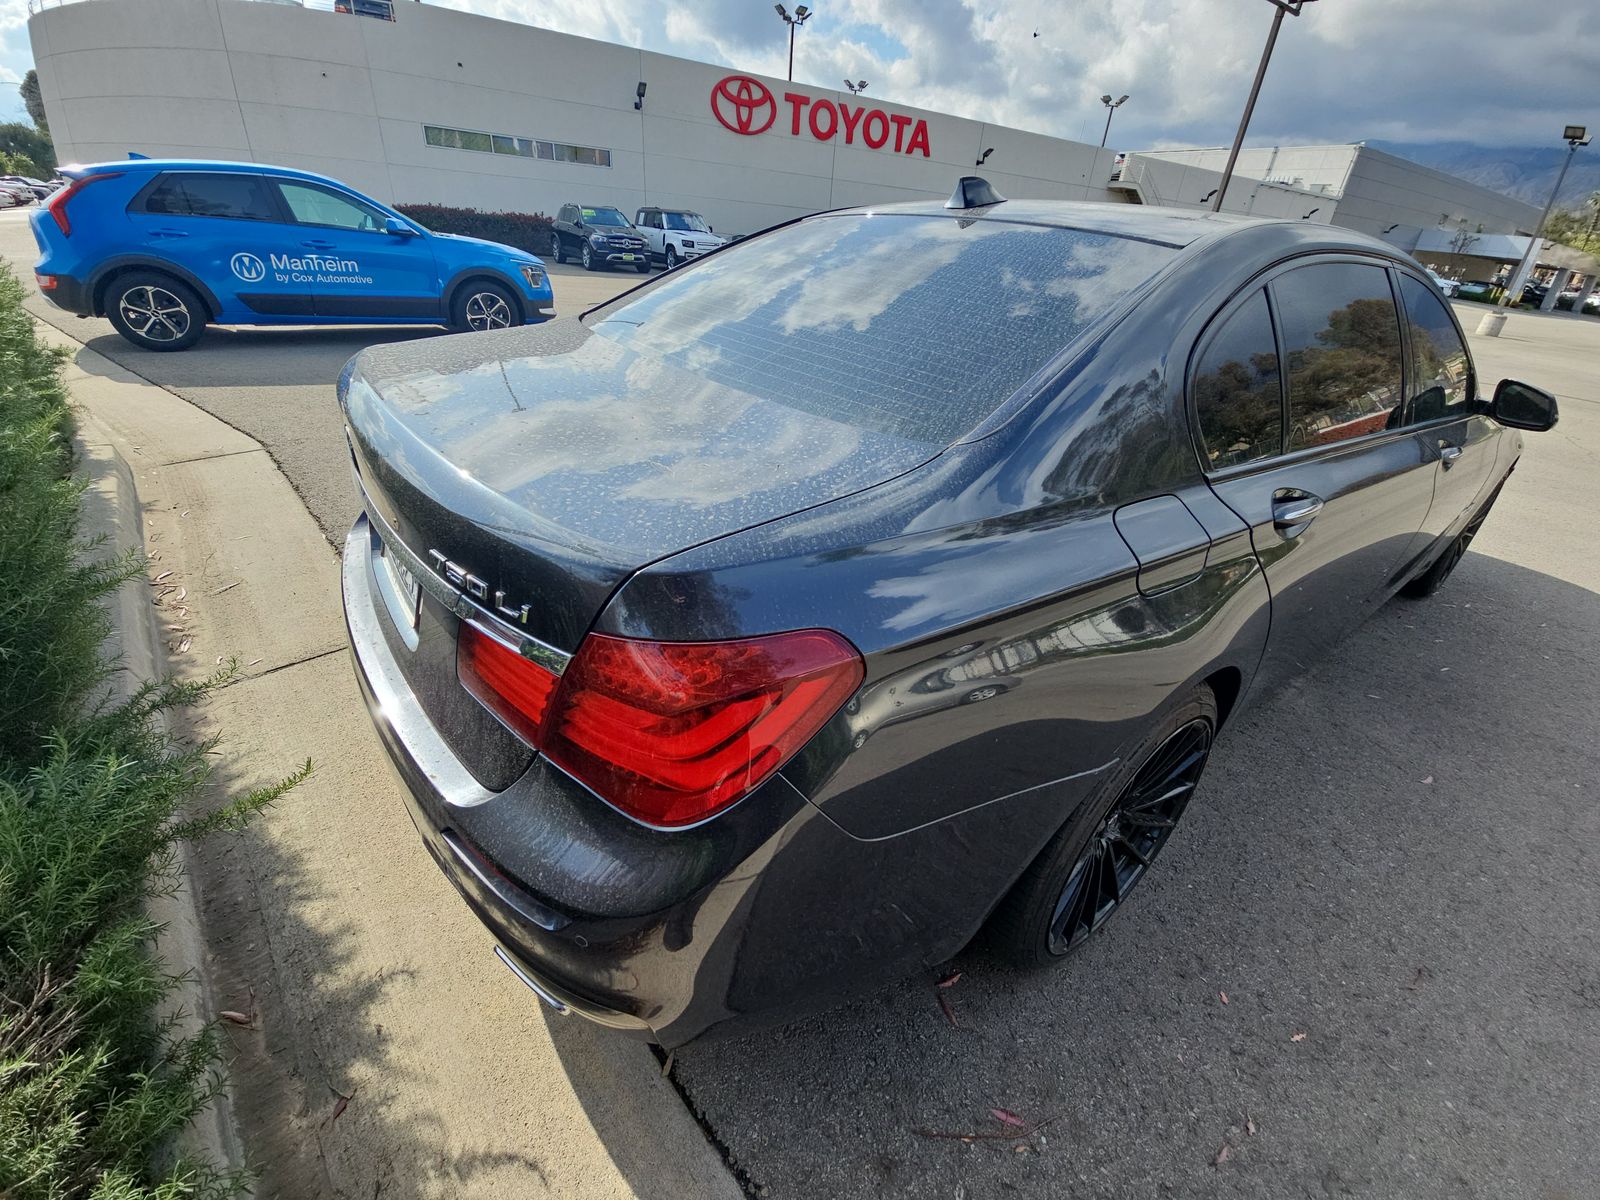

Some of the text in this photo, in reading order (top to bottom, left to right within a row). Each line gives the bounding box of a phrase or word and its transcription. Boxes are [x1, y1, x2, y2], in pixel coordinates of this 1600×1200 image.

[784, 92, 931, 158] TOYOTA
[270, 253, 359, 273] Manheim
[275, 272, 373, 284] by Cox Automotive
